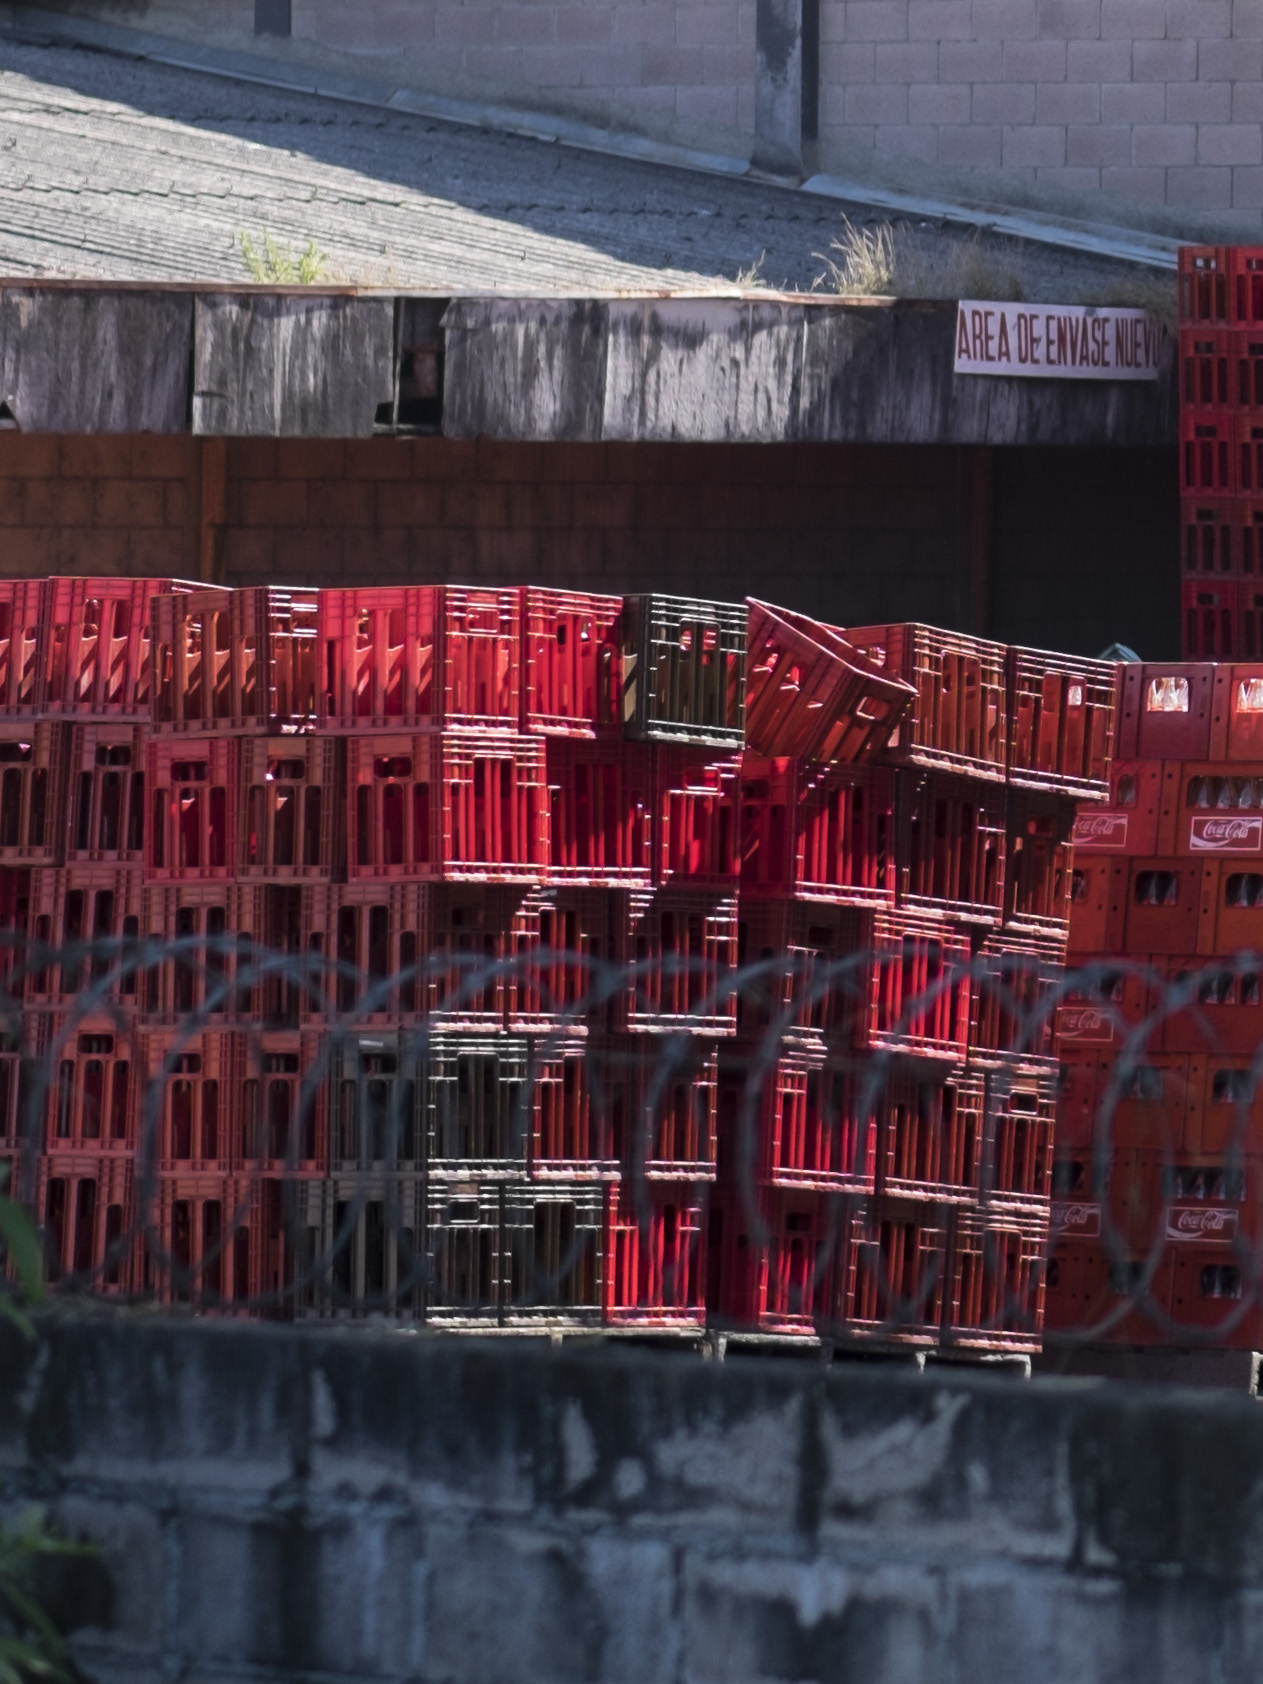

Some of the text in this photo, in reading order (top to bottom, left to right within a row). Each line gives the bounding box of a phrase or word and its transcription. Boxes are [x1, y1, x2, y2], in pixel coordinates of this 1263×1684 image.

[957, 308, 1011, 363] AREA
[1016, 312, 1040, 365] DE
[1045, 315, 1110, 368] ENVASE
